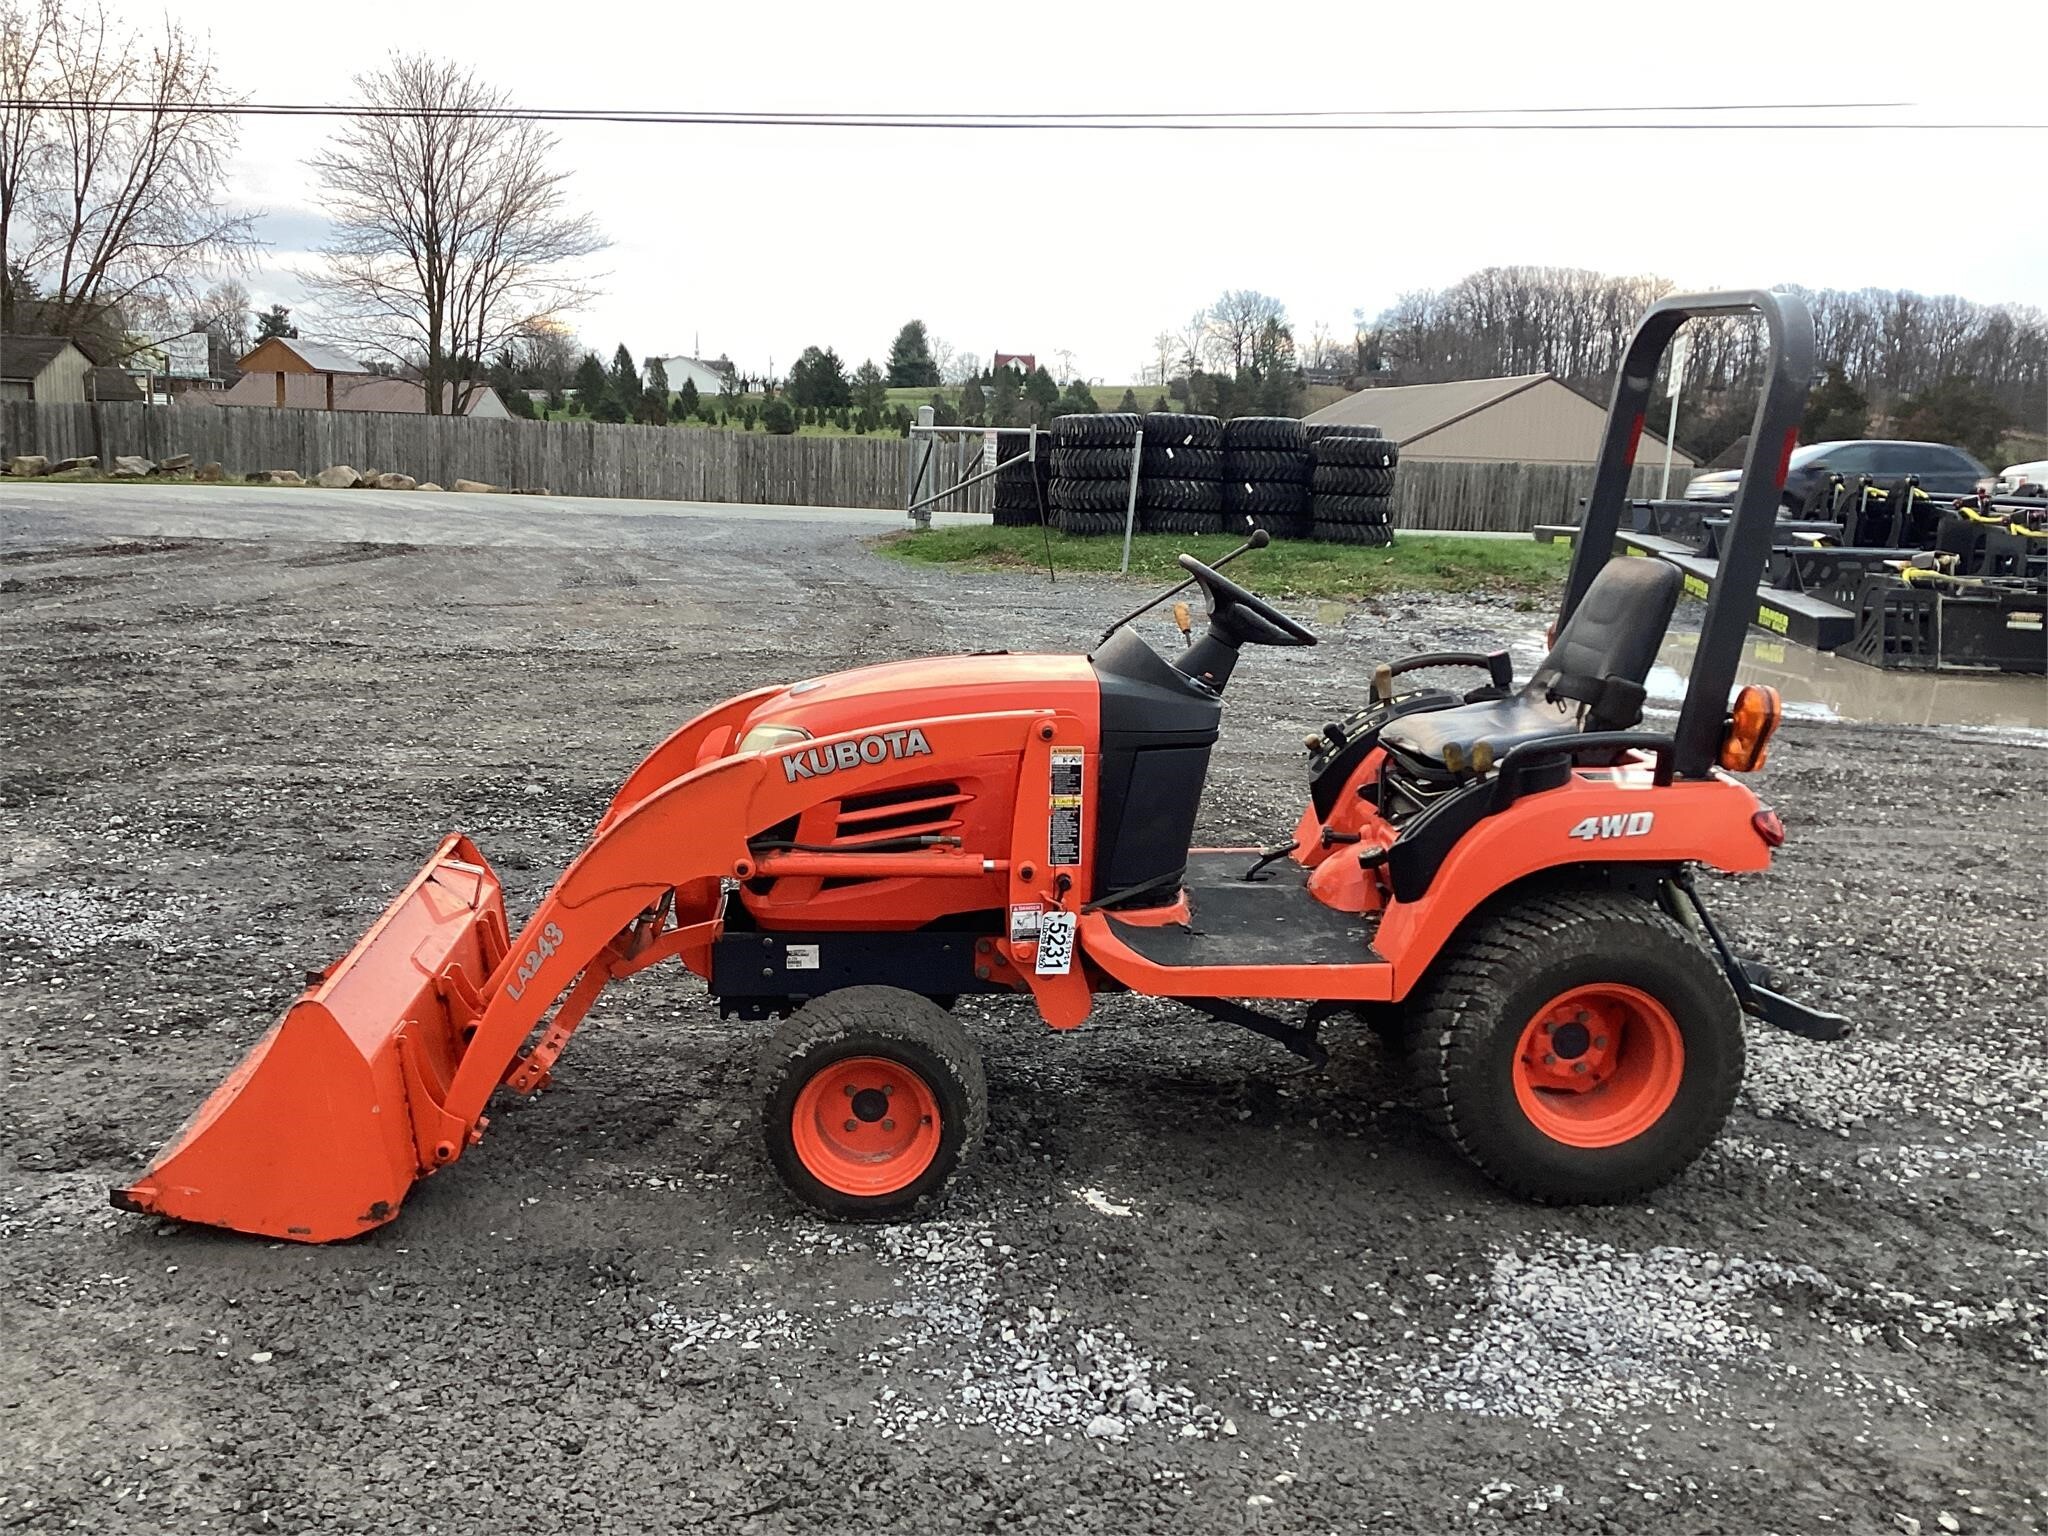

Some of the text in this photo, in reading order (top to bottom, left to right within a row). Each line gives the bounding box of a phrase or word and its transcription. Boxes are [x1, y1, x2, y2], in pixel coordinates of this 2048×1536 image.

[782, 728, 932, 783] KUBOTA
[1568, 811, 1654, 841] 4WD
[506, 922, 564, 1001] LA243
[1046, 923, 1068, 967] 5231
